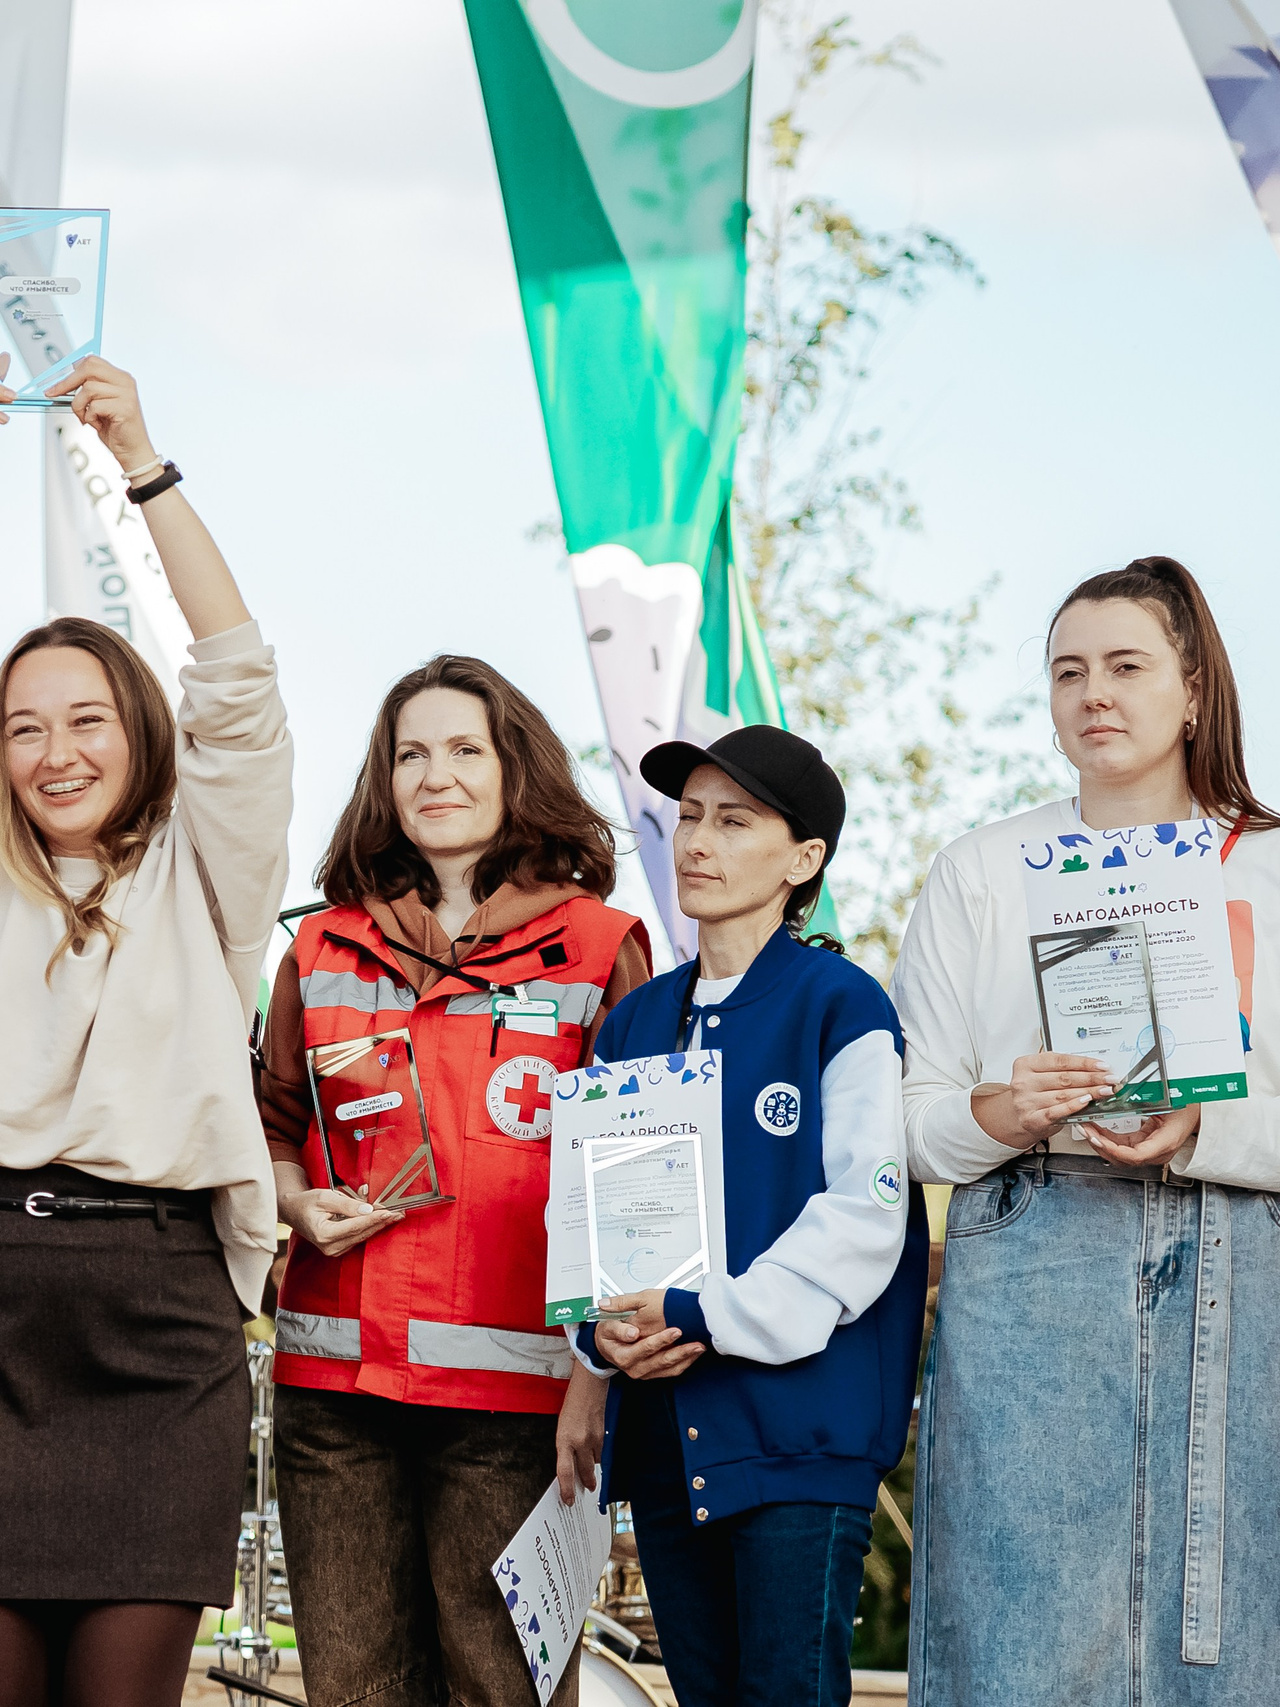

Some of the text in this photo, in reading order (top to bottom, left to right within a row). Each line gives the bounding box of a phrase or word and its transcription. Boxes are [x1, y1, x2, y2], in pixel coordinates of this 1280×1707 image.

[1053, 898, 1199, 925] БЛАГОДАРНОСТЬ
[1079, 996, 1111, 1004] СПАСИБО,
[1084, 1000, 1122, 1009] #МЫВМЕСТЕ
[354, 1098, 382, 1109] СПАСИБО,
[535, 1535, 569, 1644] БЛАГОДАРНОСТЬ
